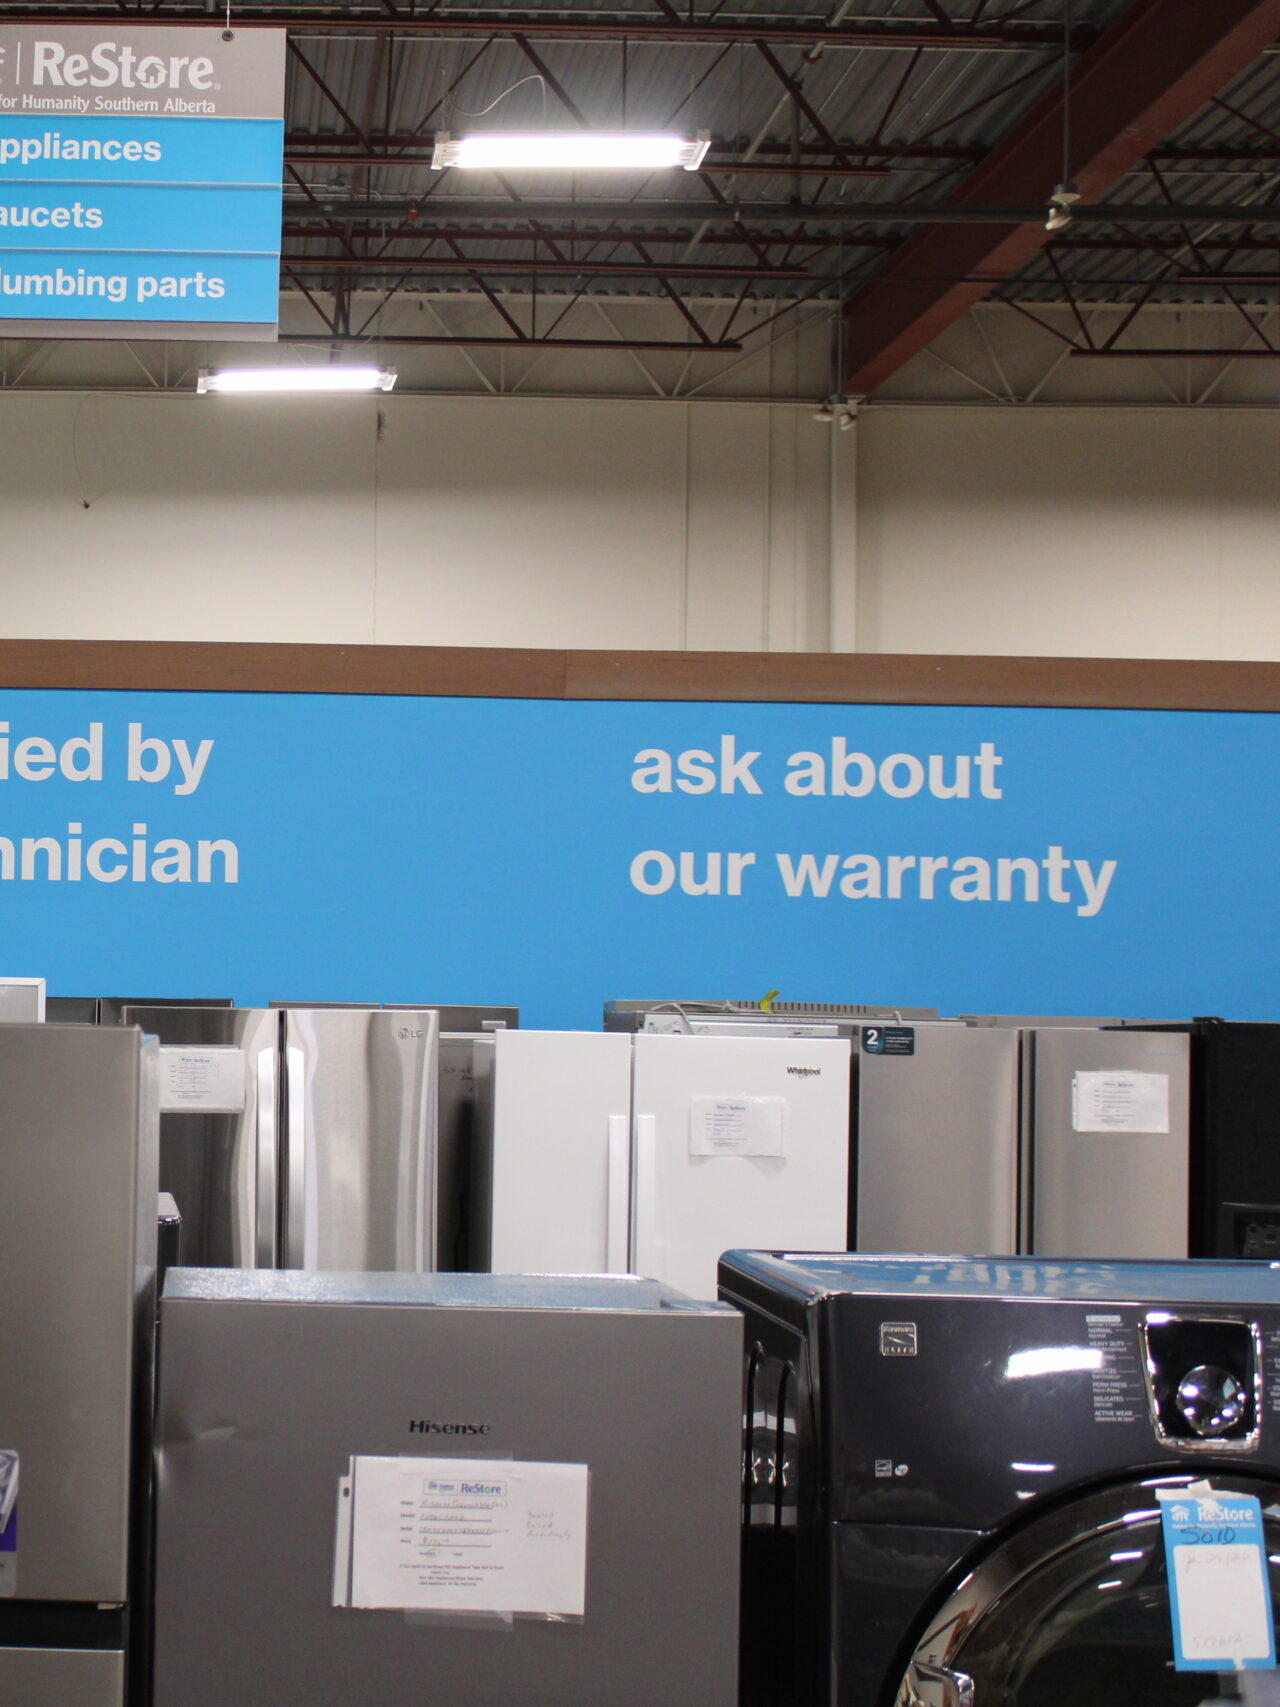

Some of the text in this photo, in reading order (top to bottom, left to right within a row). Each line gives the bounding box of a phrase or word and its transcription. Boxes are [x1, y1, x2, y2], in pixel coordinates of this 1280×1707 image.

[32, 41, 214, 90] ReStore
[22, 95, 90, 113] Humanity
[94, 96, 158, 112] Southern
[163, 98, 216, 113] Alberta
[137, 272, 226, 302] parts
[127, 722, 215, 796] by
[631, 734, 1004, 800] ask about
[629, 845, 1118, 917] our warranty
[410, 1029, 424, 1038] LG
[866, 1029, 879, 1045] 2
[786, 1066, 822, 1078] Whirlpool
[409, 1419, 491, 1436] Hisense
[460, 1482, 502, 1494] ReStore
